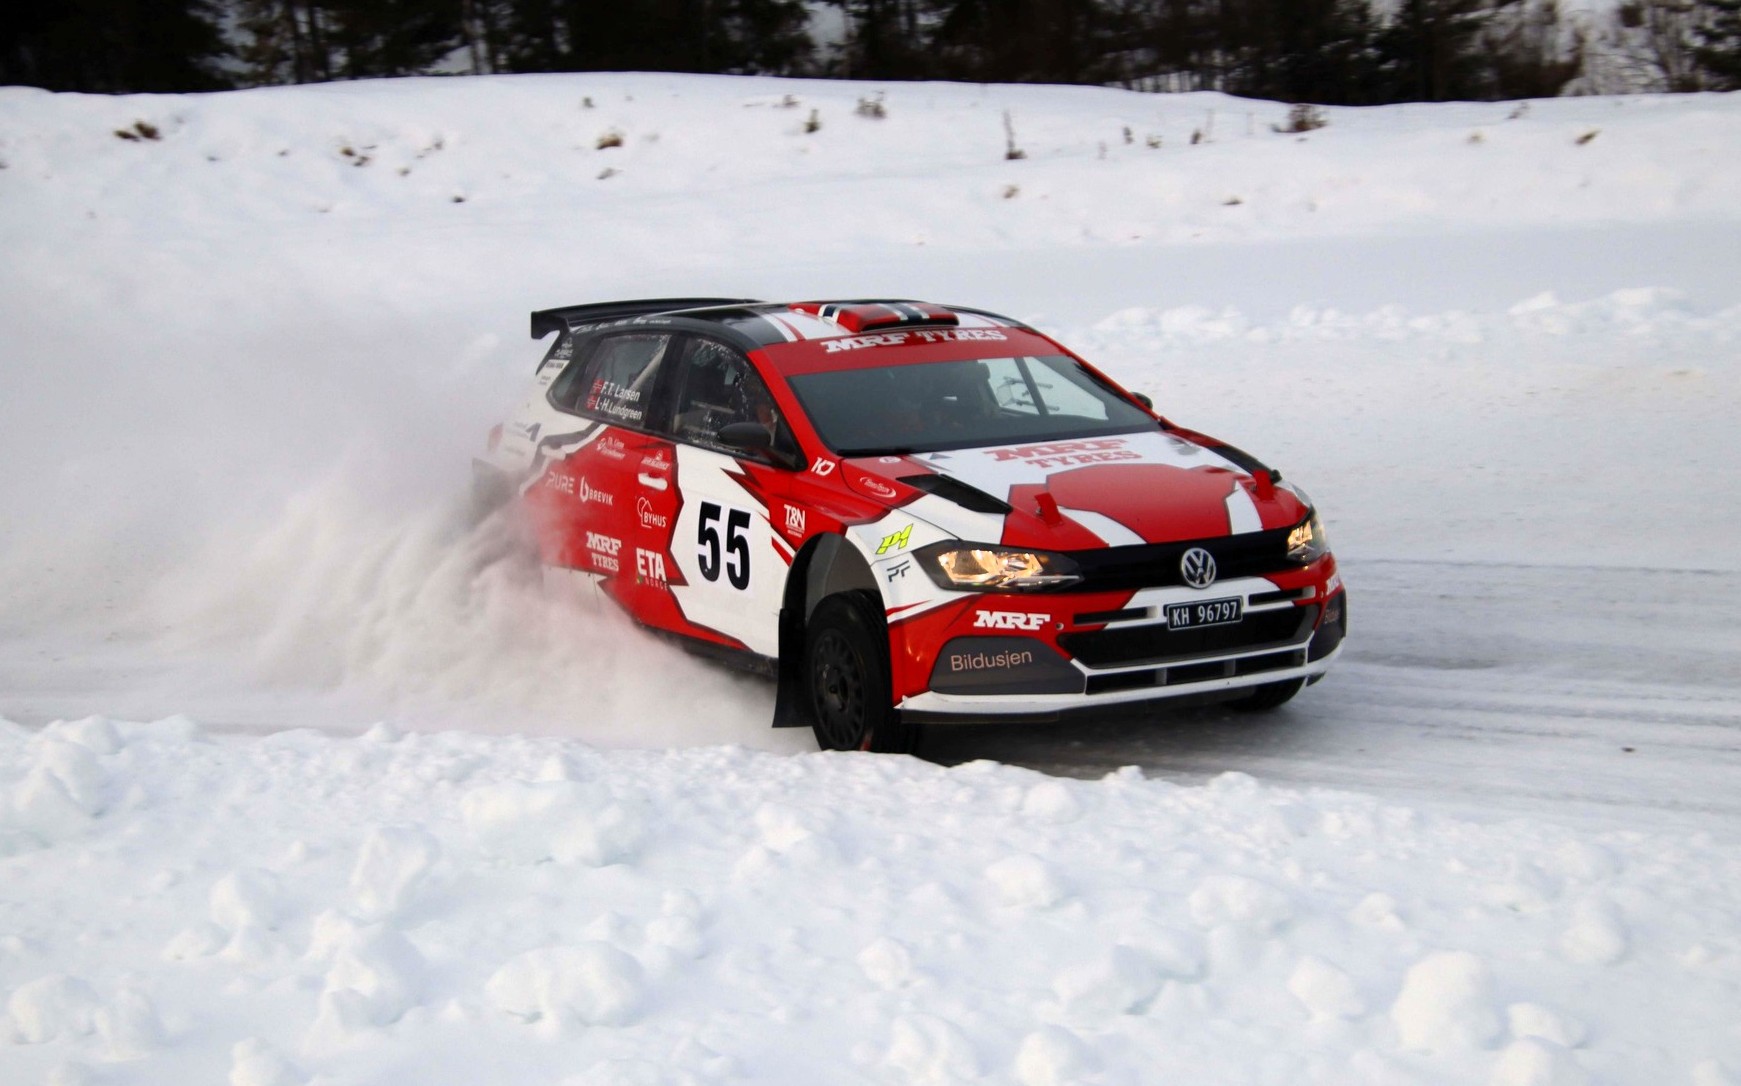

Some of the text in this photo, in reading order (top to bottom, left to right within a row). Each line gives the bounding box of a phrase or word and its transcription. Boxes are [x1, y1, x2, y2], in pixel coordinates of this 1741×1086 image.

[821, 328, 1008, 353] MRF TYRES
[614, 384, 641, 402] Larsen
[984, 439, 1127, 462] MRF
[1024, 451, 1142, 469] TYRES
[589, 488, 614, 506] BREVIK
[643, 512, 667, 528] BYHUS
[784, 503, 805, 530] T&N
[586, 531, 622, 556] MRF
[697, 501, 751, 591] 55
[591, 552, 619, 572] TYRES
[636, 547, 667, 582] ETA
[973, 610, 1051, 630] MRF
[1172, 600, 1238, 625] KH 96797
[950, 649, 1032, 672] Bildusjen
